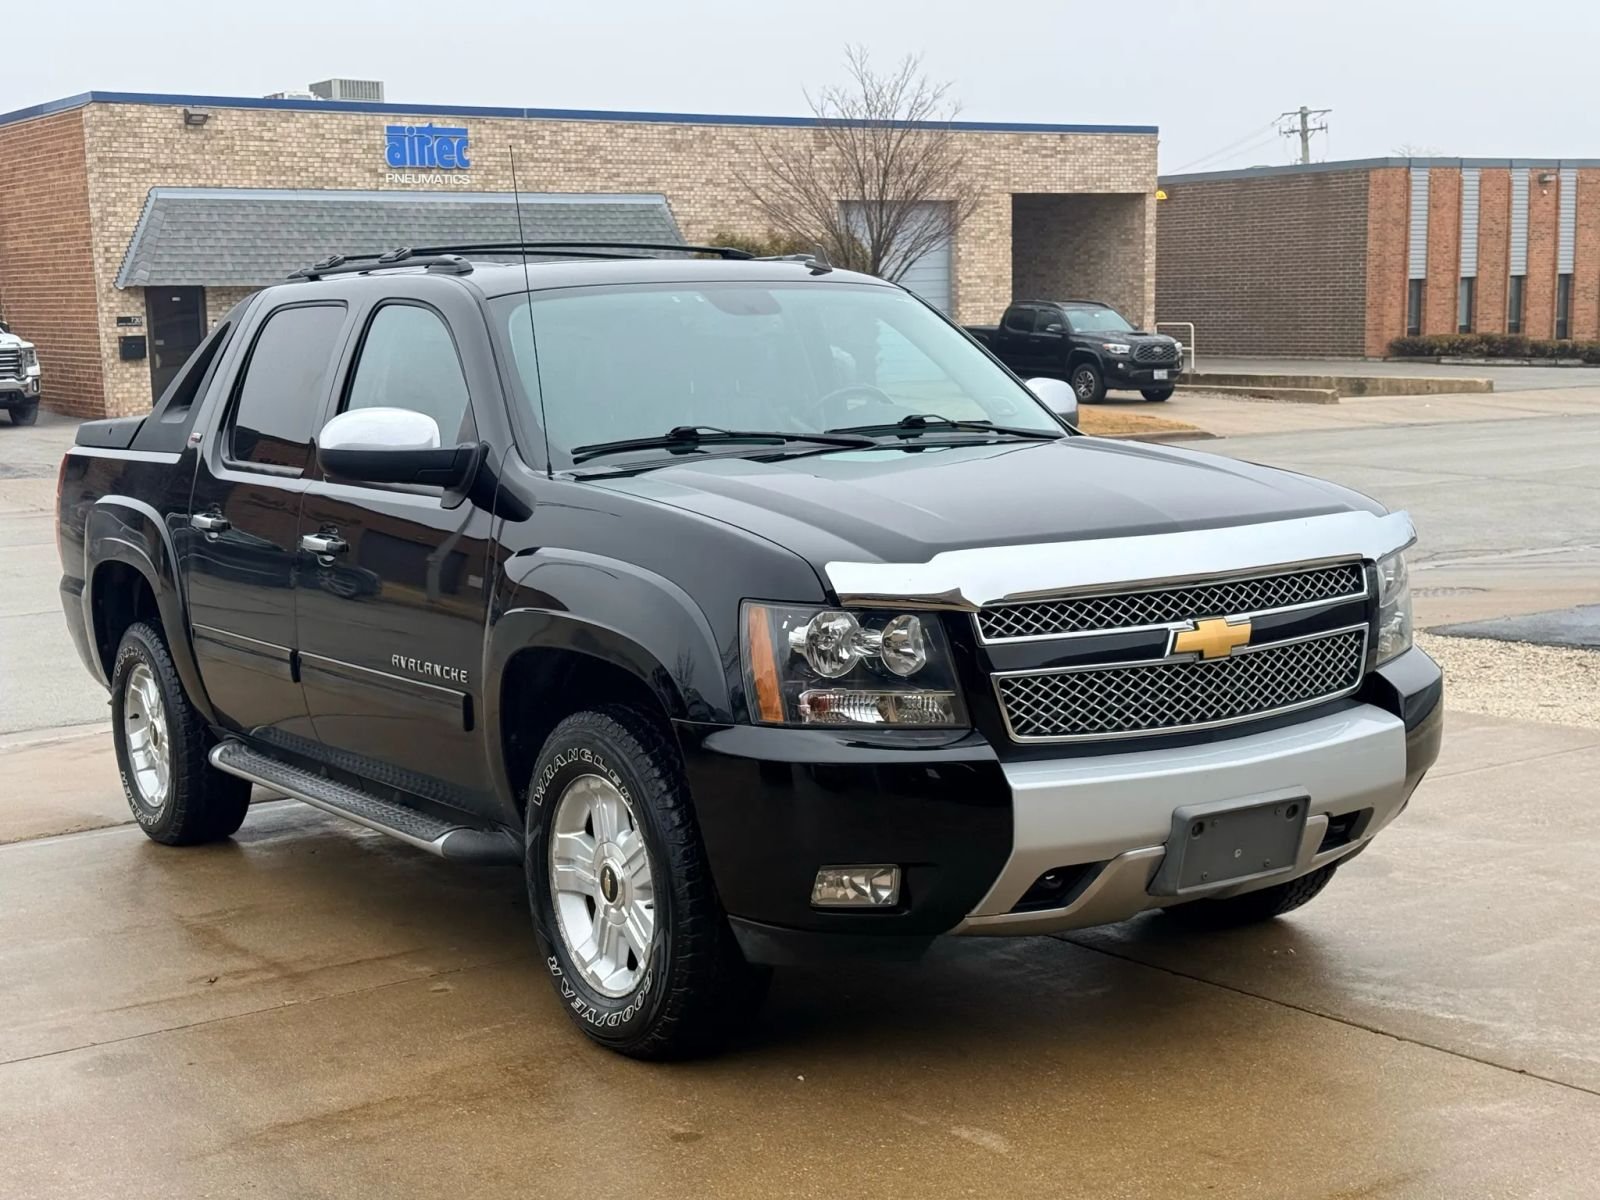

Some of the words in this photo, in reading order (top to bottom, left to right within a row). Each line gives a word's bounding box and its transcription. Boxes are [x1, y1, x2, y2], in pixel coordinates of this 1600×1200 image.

[386, 173, 471, 185] PNEUMATICS
[391, 653, 468, 683] AVALANCHE
[532, 747, 633, 806] WRANGLER
[547, 956, 653, 1027] GOODYEAR
